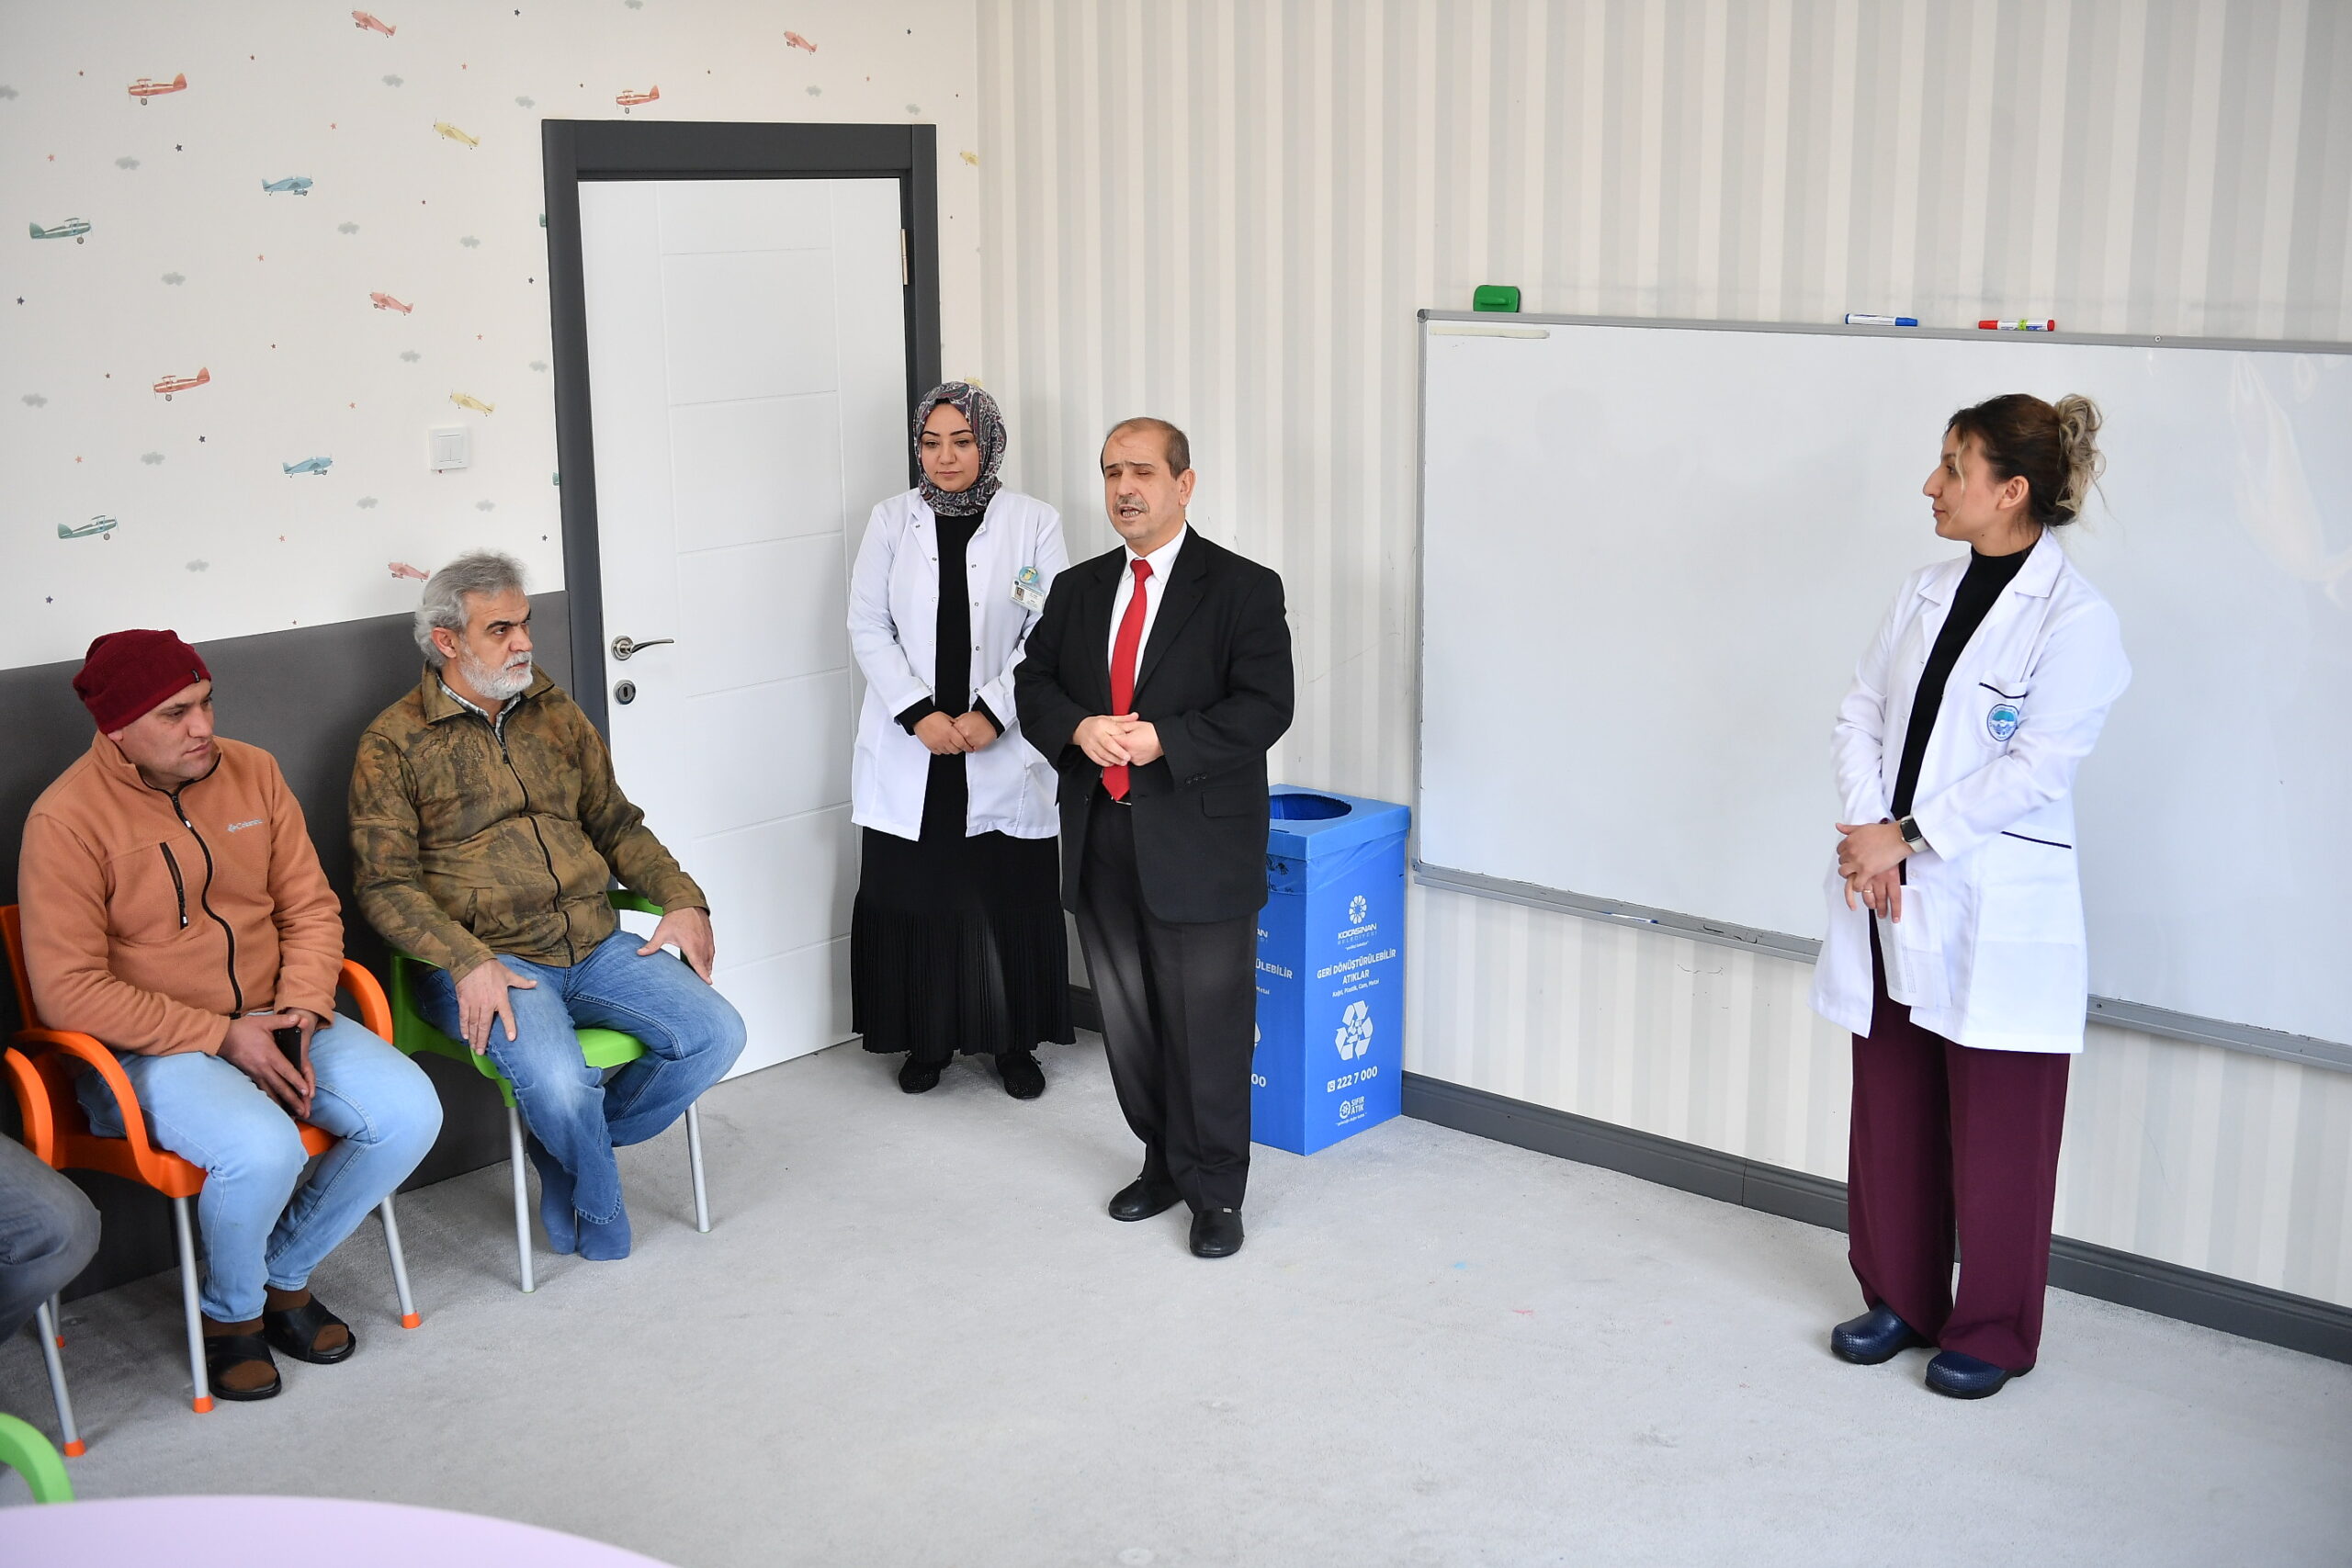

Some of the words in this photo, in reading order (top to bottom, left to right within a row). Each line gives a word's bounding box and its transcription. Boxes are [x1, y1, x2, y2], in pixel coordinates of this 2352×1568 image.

[1255, 957, 1293, 979] ÜLEBİLİR
[1317, 964, 1332, 979] GERİ
[1332, 947, 1396, 975] DÖNÜŞTÜRÜLEBİLİR
[1342, 969, 1370, 985] ATIKLAR
[1250, 1073, 1267, 1088] 00
[1337, 1074, 1352, 1089] 222
[1353, 1071, 1360, 1084] 7
[1360, 1065, 1378, 1081] 000
[1351, 1102, 1364, 1114] ATIK
